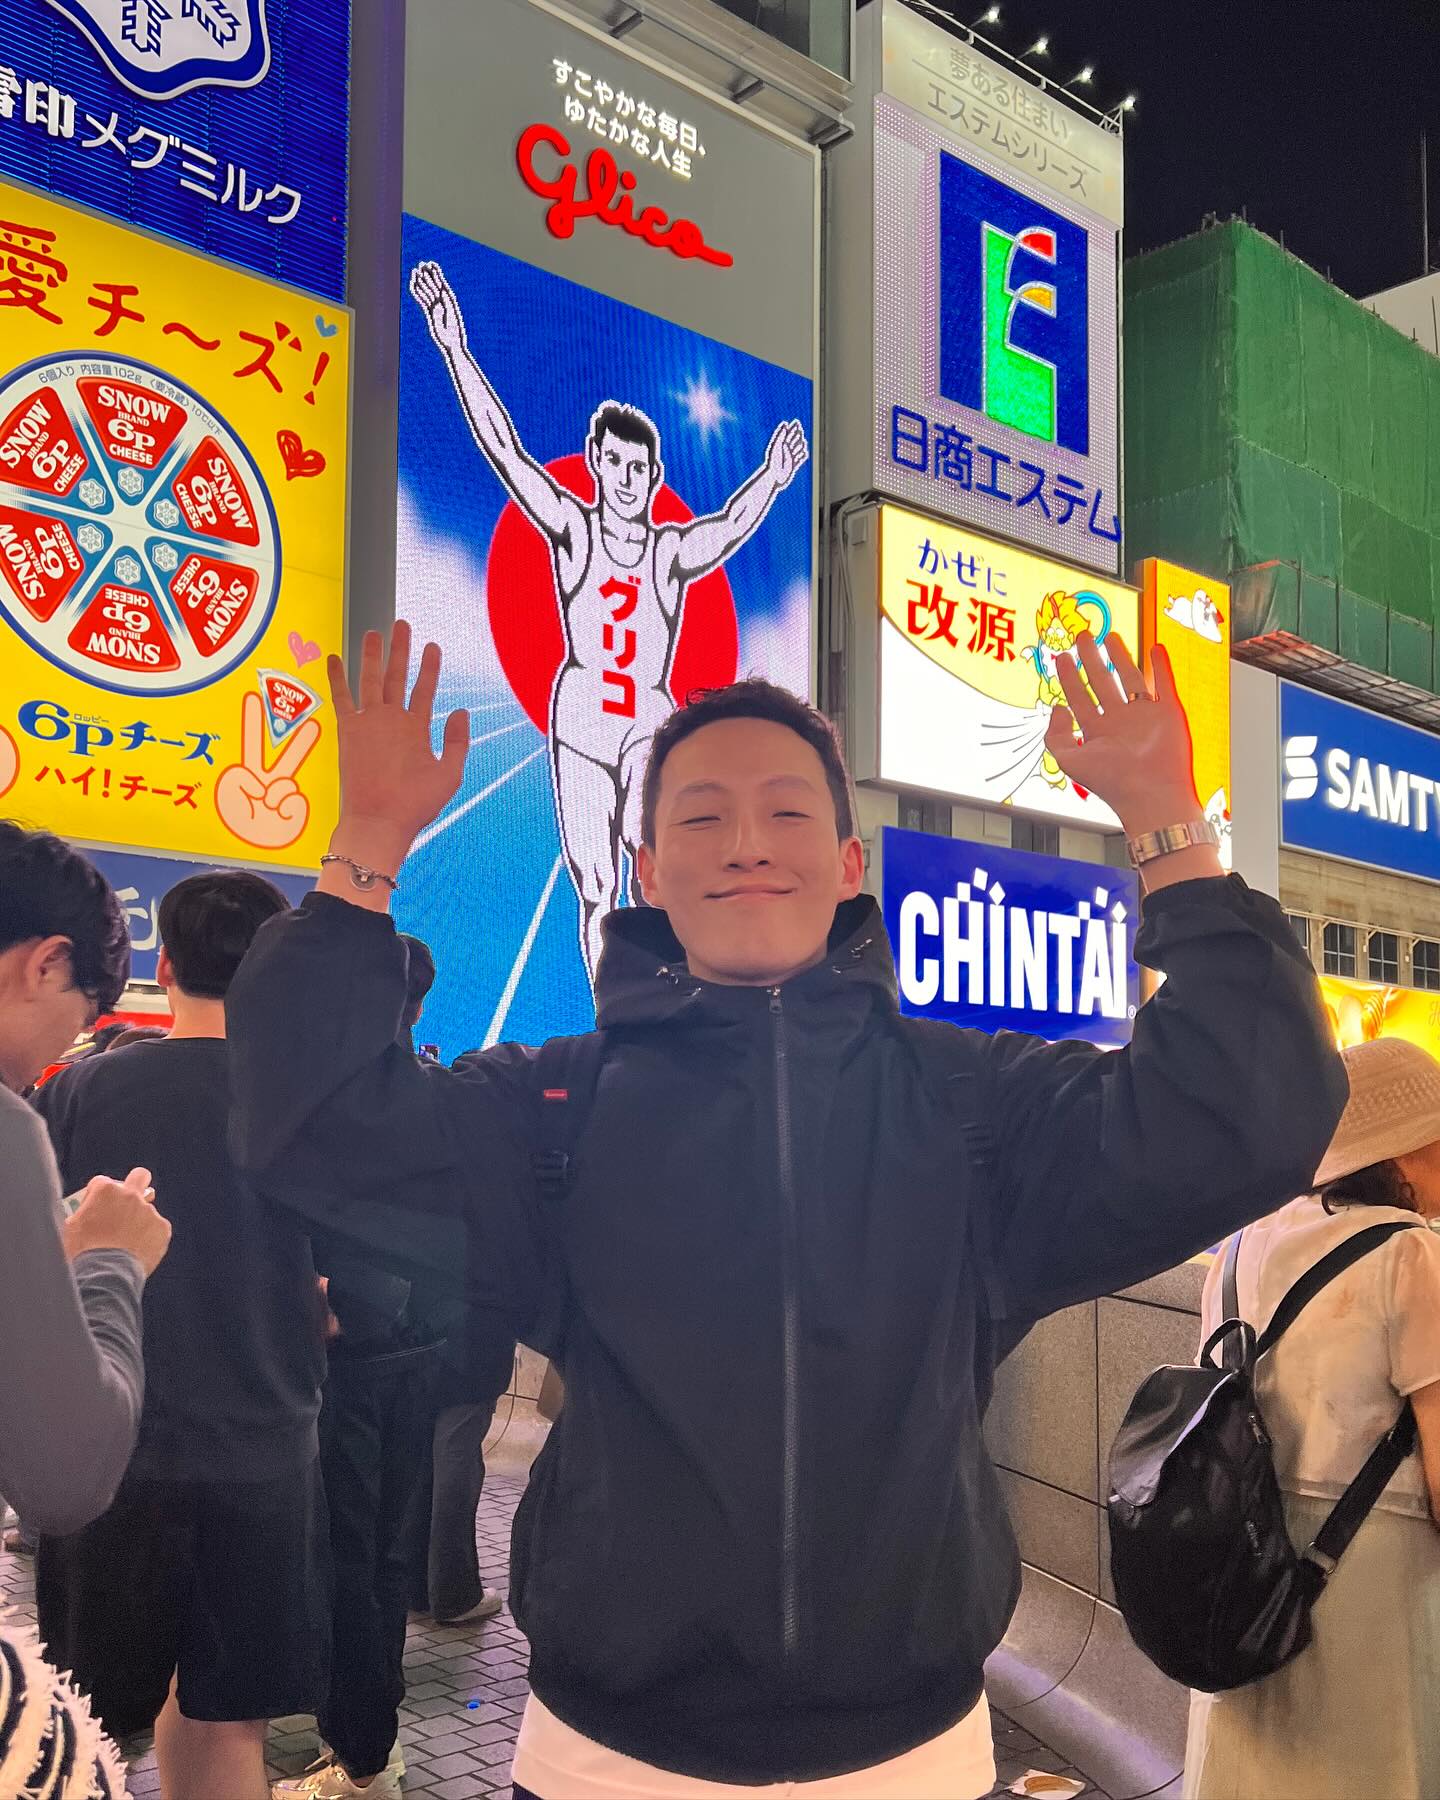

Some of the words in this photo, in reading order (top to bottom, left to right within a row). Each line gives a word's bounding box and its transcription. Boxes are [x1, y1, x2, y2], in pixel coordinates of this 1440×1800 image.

[552, 57, 706, 156] すこやかな毎日、
[950, 47, 1068, 139] 夢ある住まい
[564, 95, 692, 179] ゆたかな人生
[927, 81, 1087, 198] エステムシリーズ
[516, 123, 733, 267] Glico
[38, 365, 75, 383] 6個入り
[98, 385, 171, 424] SNOW
[118, 411, 150, 427] BRAND
[0, 398, 52, 469] SNOW
[26, 431, 50, 460] BRAND
[108, 418, 156, 451] 6P
[109, 443, 153, 465] CHEESE
[32, 439, 71, 479] 6P
[53, 453, 85, 493] CHEESE
[892, 404, 1122, 544] 日商エステム
[176, 483, 202, 529] CHEESE
[191, 475, 217, 525] 6P
[207, 457, 253, 530] SNOW
[209, 481, 228, 514] BRAND
[0, 524, 46, 600] SNOW
[23, 539, 43, 574] BRAND
[35, 527, 64, 579] 6P
[52, 523, 80, 570] CHEESE
[917, 537, 1008, 597] かぜに
[105, 588, 149, 607] CHEESE
[173, 557, 201, 596] CHEESE
[187, 570, 220, 608] 6P
[102, 602, 151, 633] 6P
[203, 578, 249, 646] SNOW
[205, 587, 225, 615] BRAND
[906, 578, 1016, 665] 改源
[86, 632, 160, 664] SNOW
[108, 627, 141, 640] BRAND
[598, 575, 642, 719] グリコ
[273, 682, 306, 703] SNOW
[900, 867, 1127, 1018] CHINTAI
